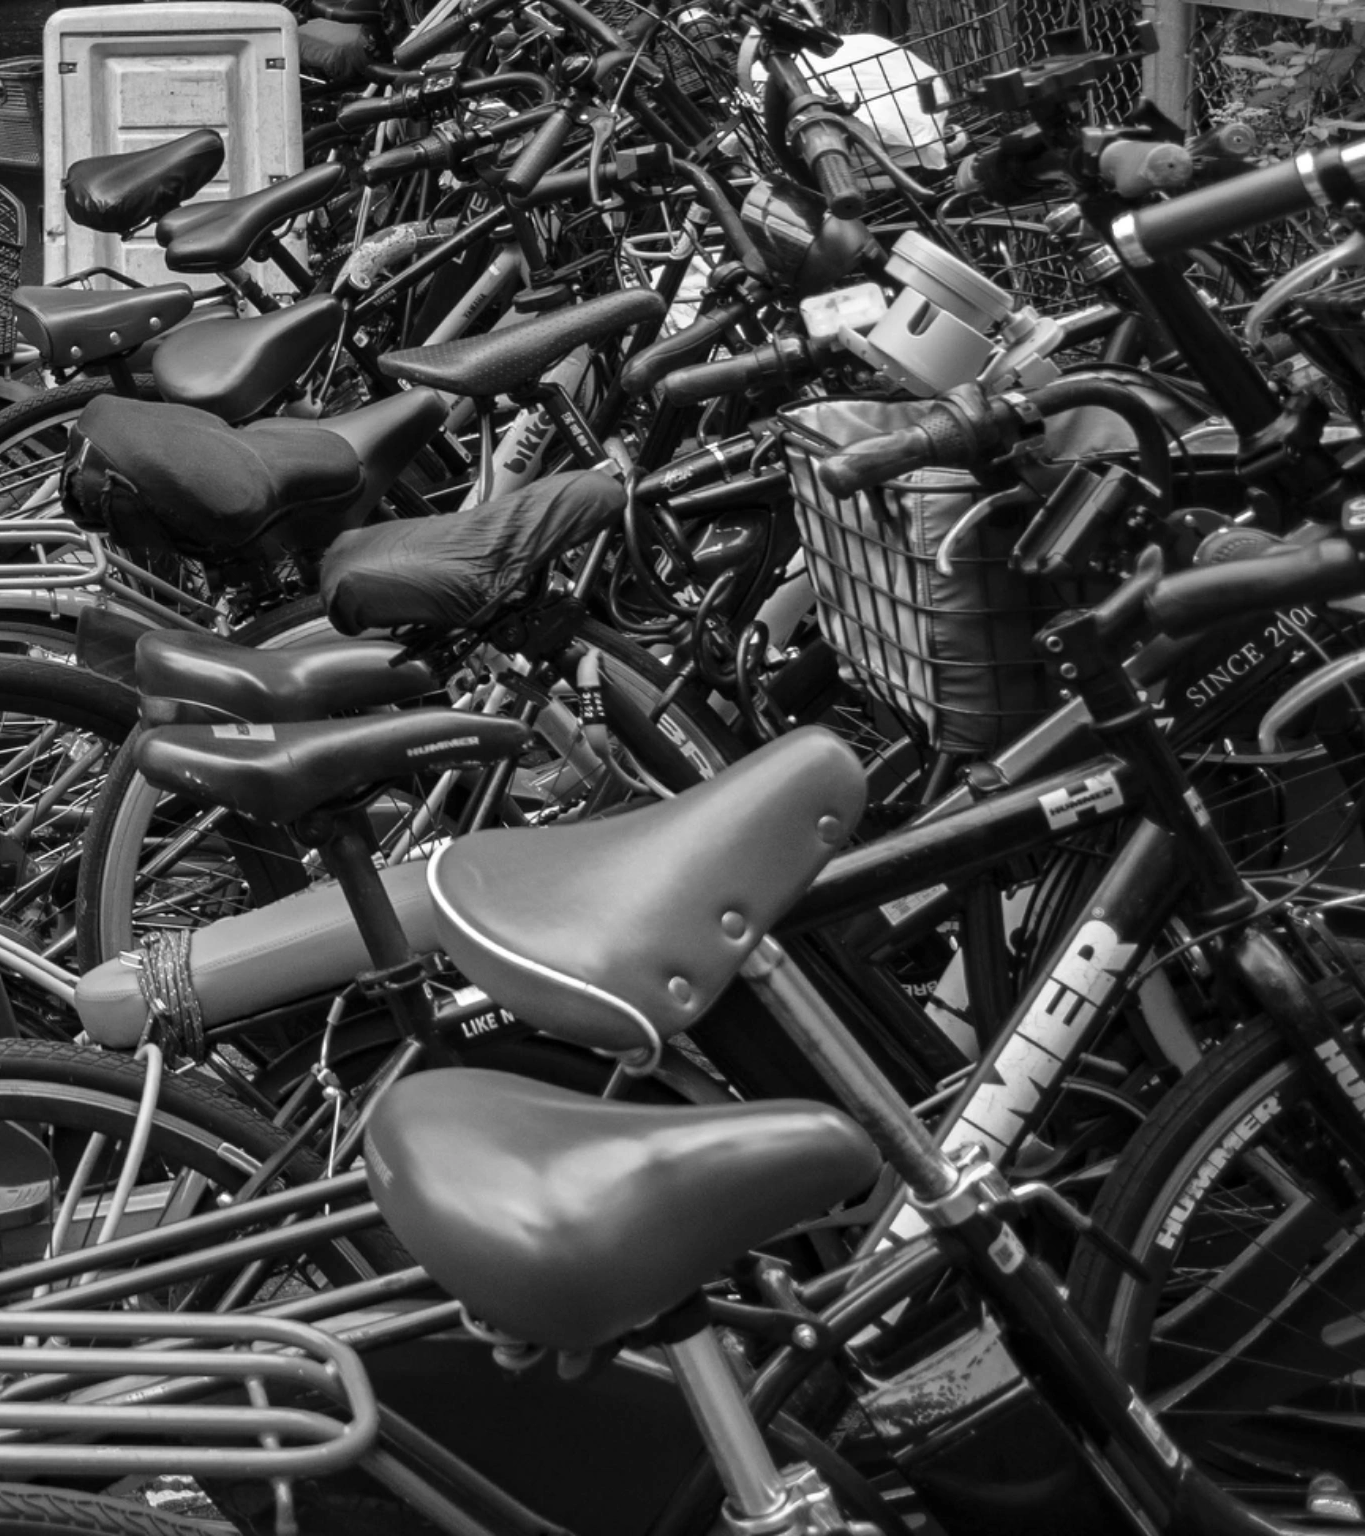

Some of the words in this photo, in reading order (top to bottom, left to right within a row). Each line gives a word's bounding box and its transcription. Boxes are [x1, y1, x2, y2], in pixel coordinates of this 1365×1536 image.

[1185, 641, 1265, 708] SINCE
[406, 735, 480, 758] HUMMER
[1049, 785, 1117, 819] HUMMER
[460, 1011, 500, 1039] LIKE
[1154, 1092, 1281, 1251] HUMMER
